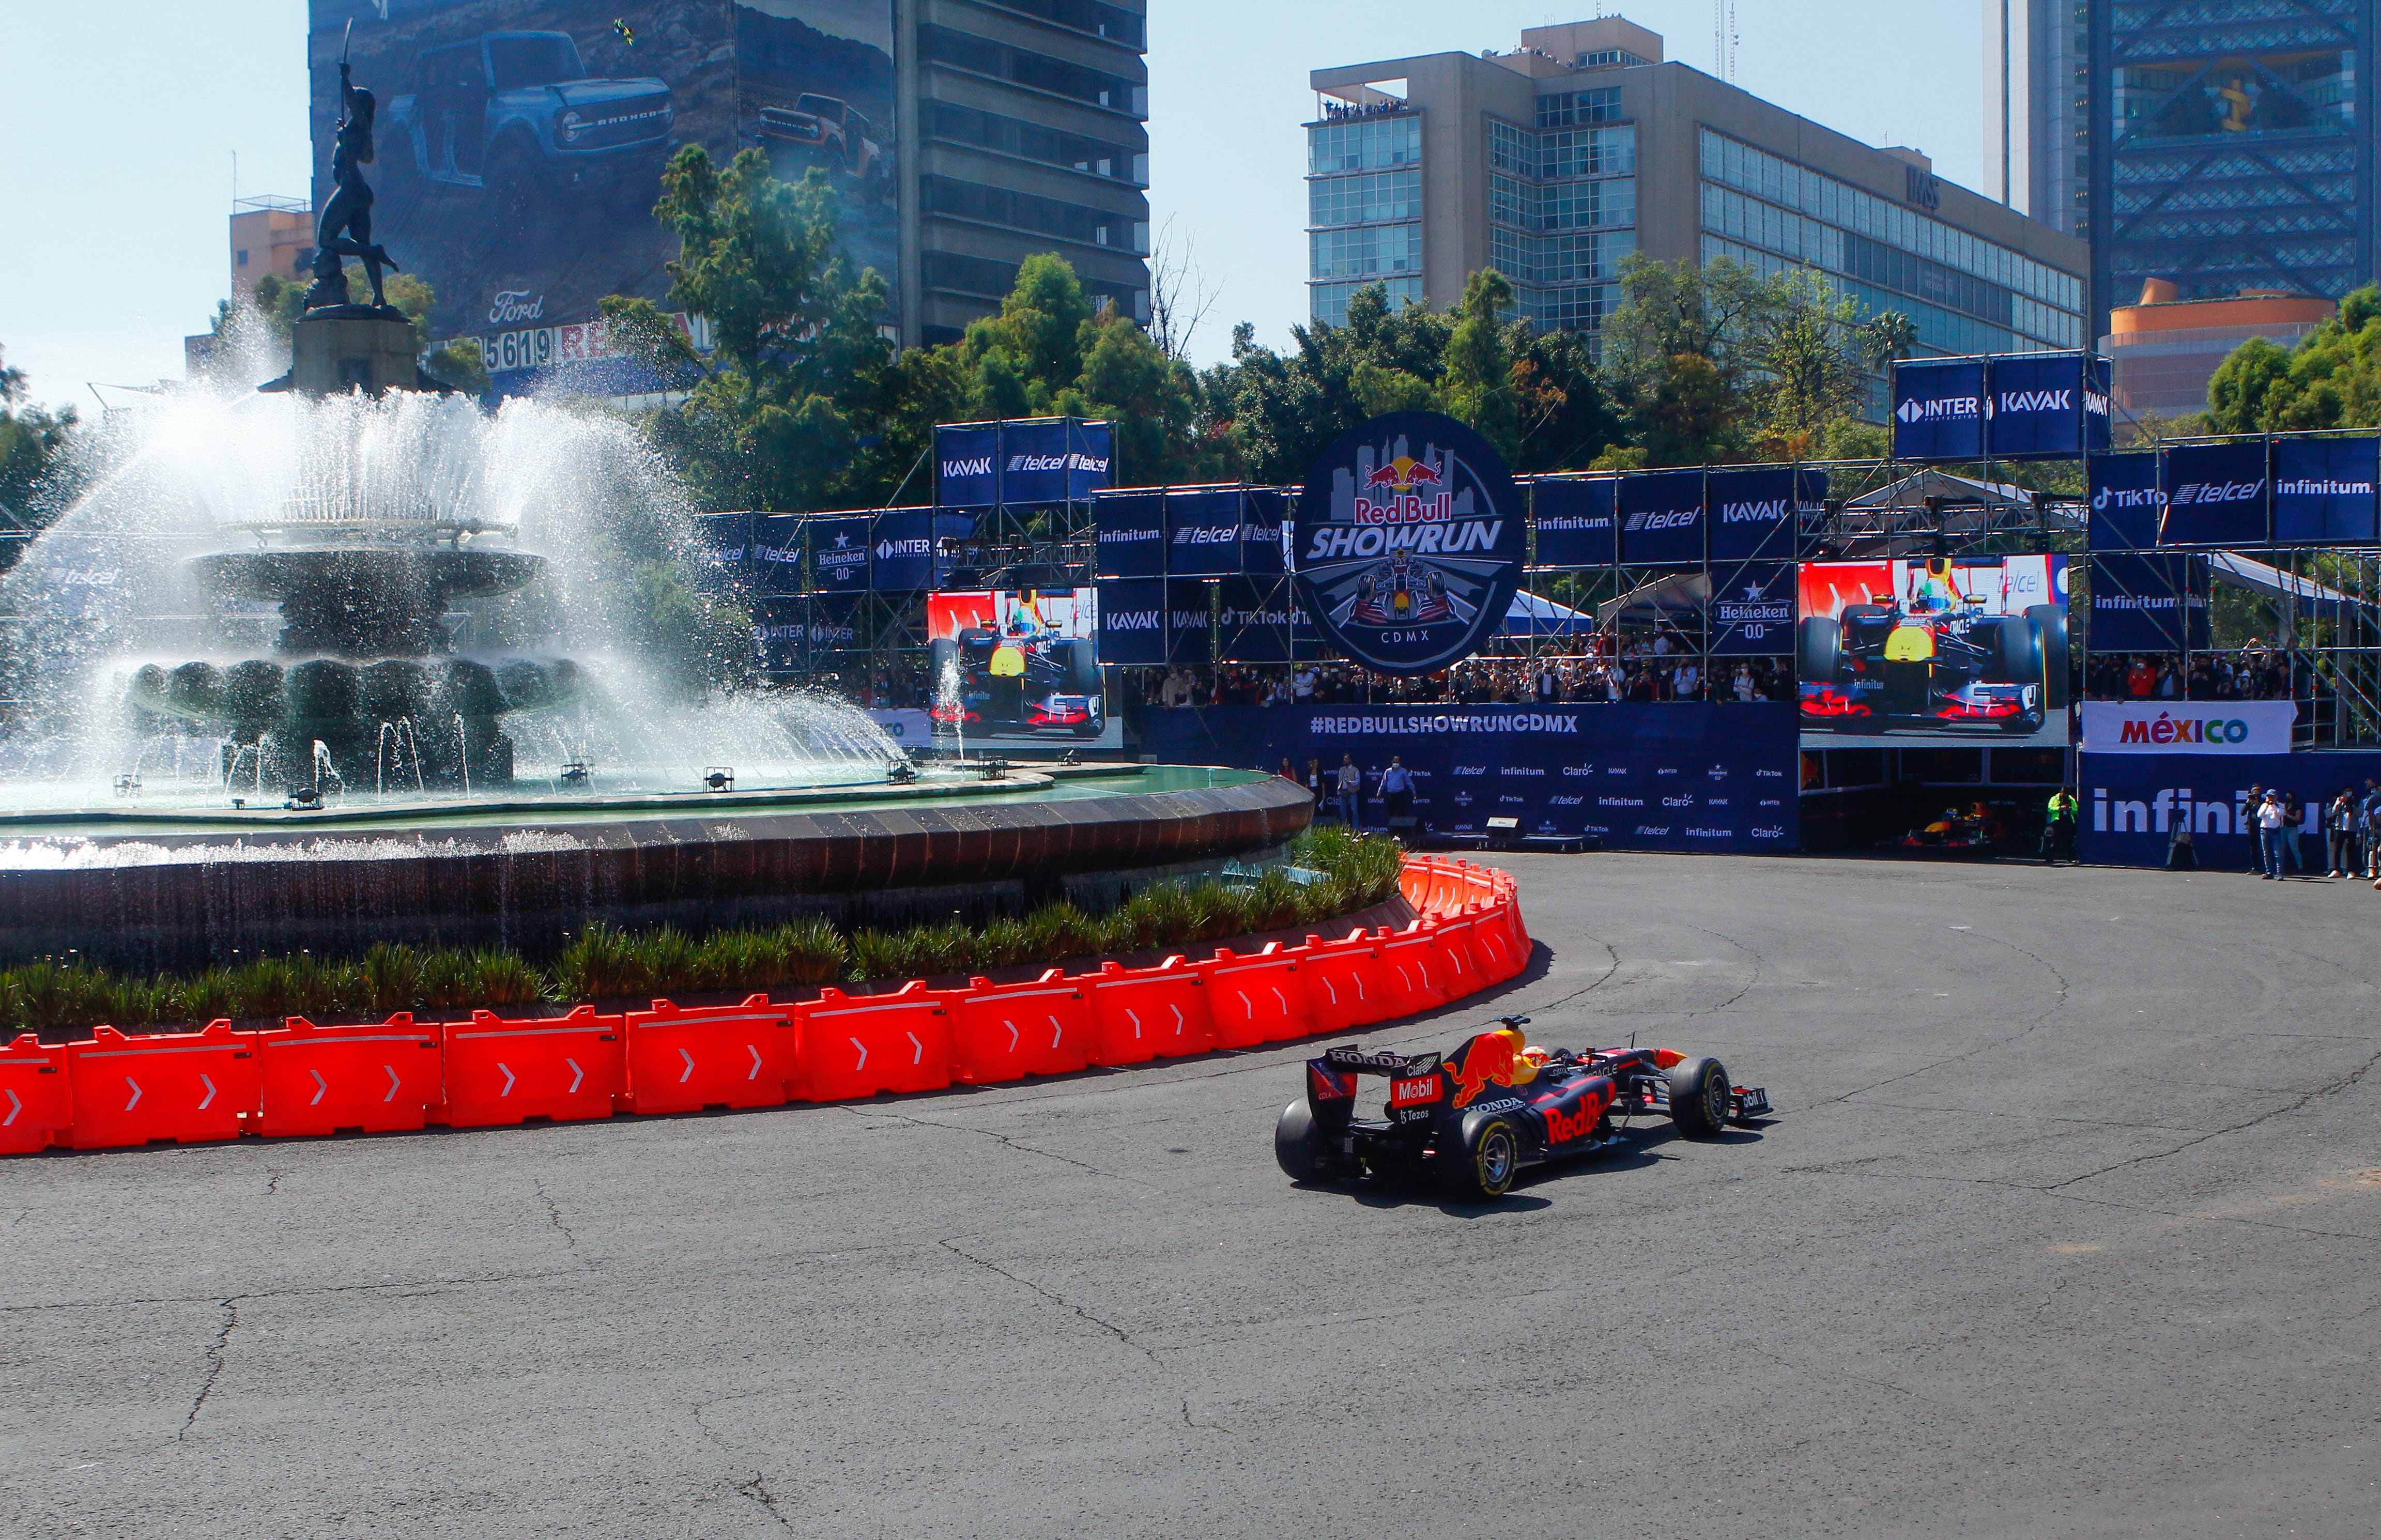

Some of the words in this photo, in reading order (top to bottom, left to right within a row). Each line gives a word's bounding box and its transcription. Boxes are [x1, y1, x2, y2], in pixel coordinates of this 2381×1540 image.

[489, 289, 544, 324] Ford
[472, 330, 550, 368] 5619
[1925, 397, 1978, 417] INTER
[2001, 389, 2071, 412] KAVAK
[2085, 390, 2109, 416] KAVAK
[943, 457, 992, 477] KAVAK
[1022, 453, 1068, 471] telcel
[1078, 455, 1109, 473] telcel
[2114, 488, 2168, 507] TikTo
[2195, 478, 2265, 503] telcel
[1354, 494, 1402, 526] Red
[1404, 492, 1451, 524] Bull
[1645, 506, 1700, 530] telcel
[1723, 499, 1788, 523] KAVAK
[1190, 523, 1239, 543] telcel
[1252, 525, 1281, 542] telcel
[1306, 520, 1503, 559] SHOWRUN
[764, 546, 800, 563] telcel
[895, 539, 930, 554] INTER
[819, 550, 865, 566] Heineken
[1997, 570, 2039, 593] telcel
[1107, 611, 1159, 630] KAVAK
[1173, 610, 1208, 629] KAVAK
[1237, 610, 1287, 625] TikTok
[1719, 605, 1789, 620] Heineken
[771, 624, 804, 638] INTER
[825, 626, 853, 640] INTER
[1381, 629, 1430, 643] CDMX
[1311, 714, 1578, 733] #REDBULLSHOWRUNCDMX
[1461, 766, 1486, 775] telcel
[1562, 766, 1589, 776] Claro
[1558, 796, 1583, 804] telcel
[1662, 796, 1688, 806] Claro
[1643, 826, 1669, 835] telcel
[1751, 828, 1779, 838] Claro
[1329, 1051, 1406, 1067] HONDA
[1399, 1078, 1433, 1100] Mobil
[1408, 1109, 1429, 1121] Tezos
